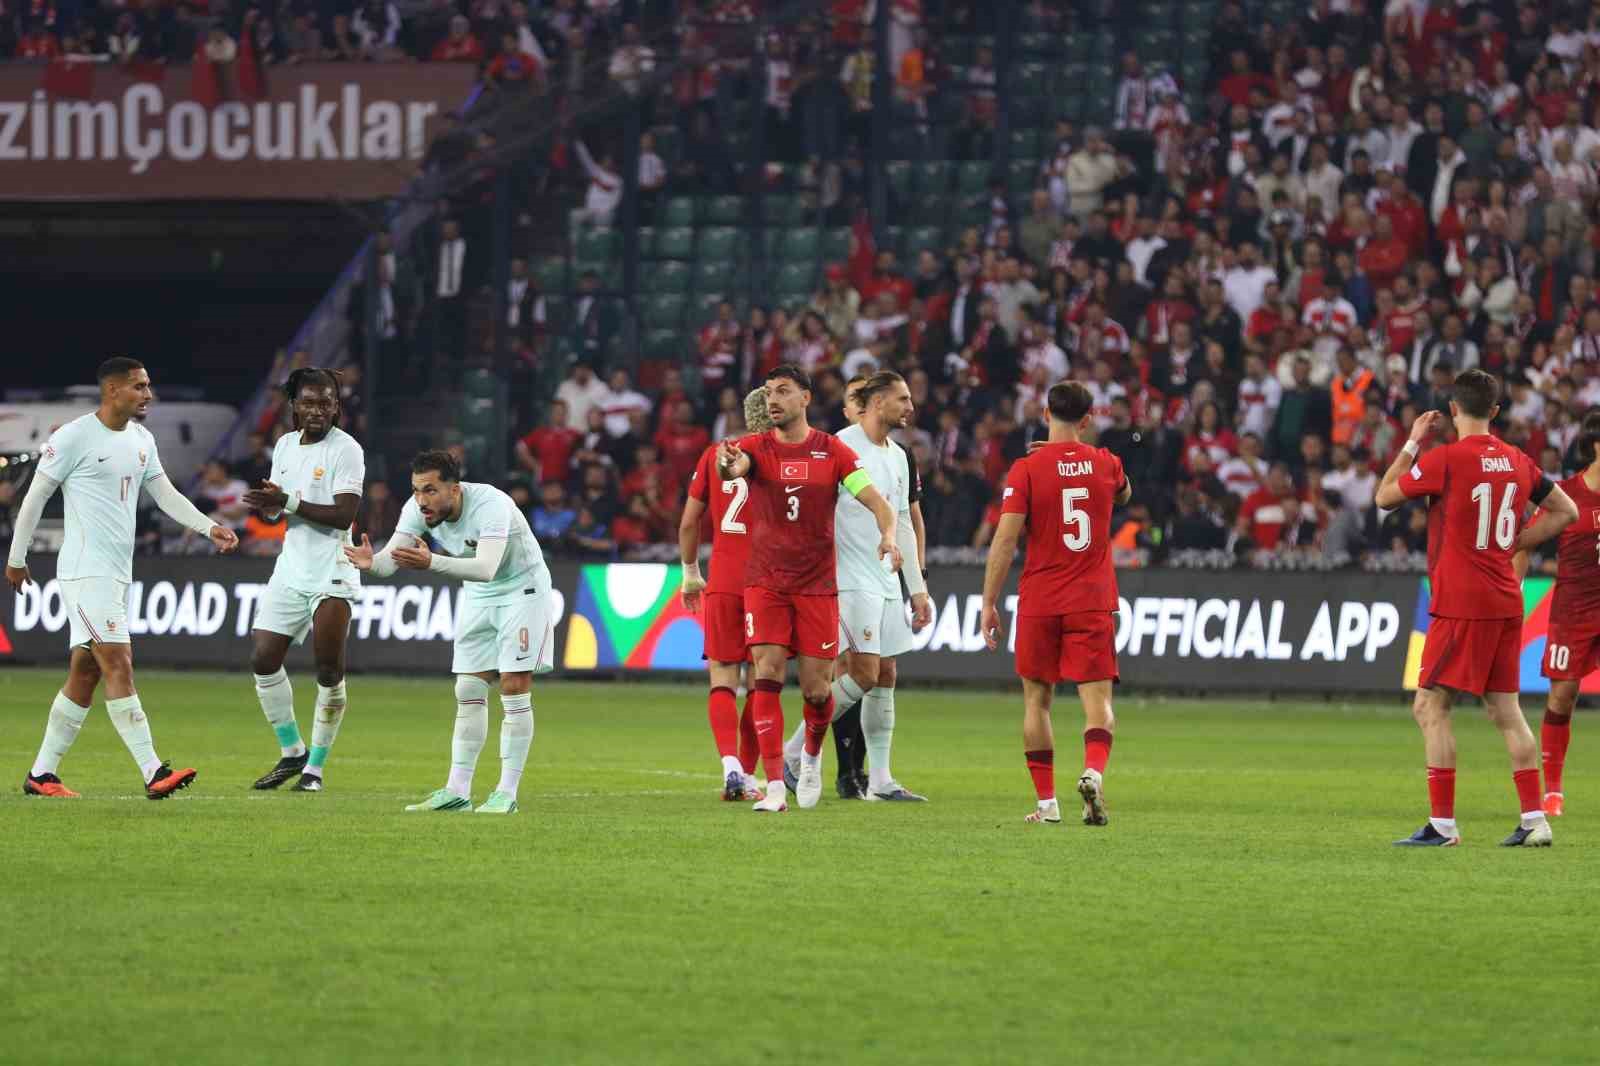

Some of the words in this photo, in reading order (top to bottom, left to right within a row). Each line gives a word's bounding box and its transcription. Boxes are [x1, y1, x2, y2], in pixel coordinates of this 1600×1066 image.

[786, 495, 800, 521] 3
[1062, 487, 1091, 552] 5
[1471, 482, 1517, 551] 16
[745, 612, 755, 638] 3
[1299, 600, 1400, 663] APP
[519, 627, 529, 652] 9
[1549, 643, 1570, 671] 10
